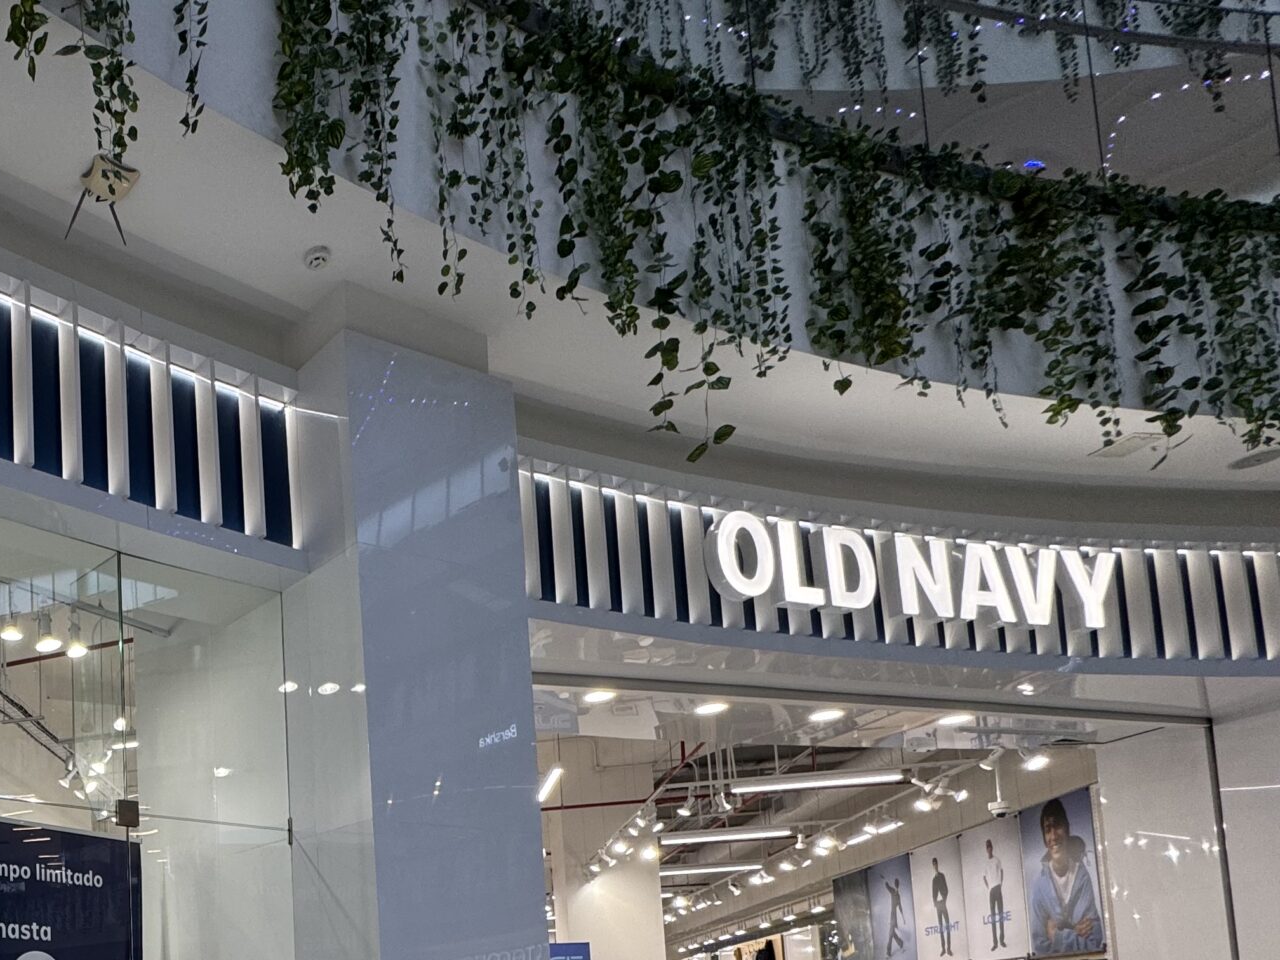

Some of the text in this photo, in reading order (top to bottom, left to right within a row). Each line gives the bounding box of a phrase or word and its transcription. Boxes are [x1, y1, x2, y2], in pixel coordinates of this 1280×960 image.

[704, 510, 1116, 629] OLD NAVY
[35, 863, 104, 888] limitado
